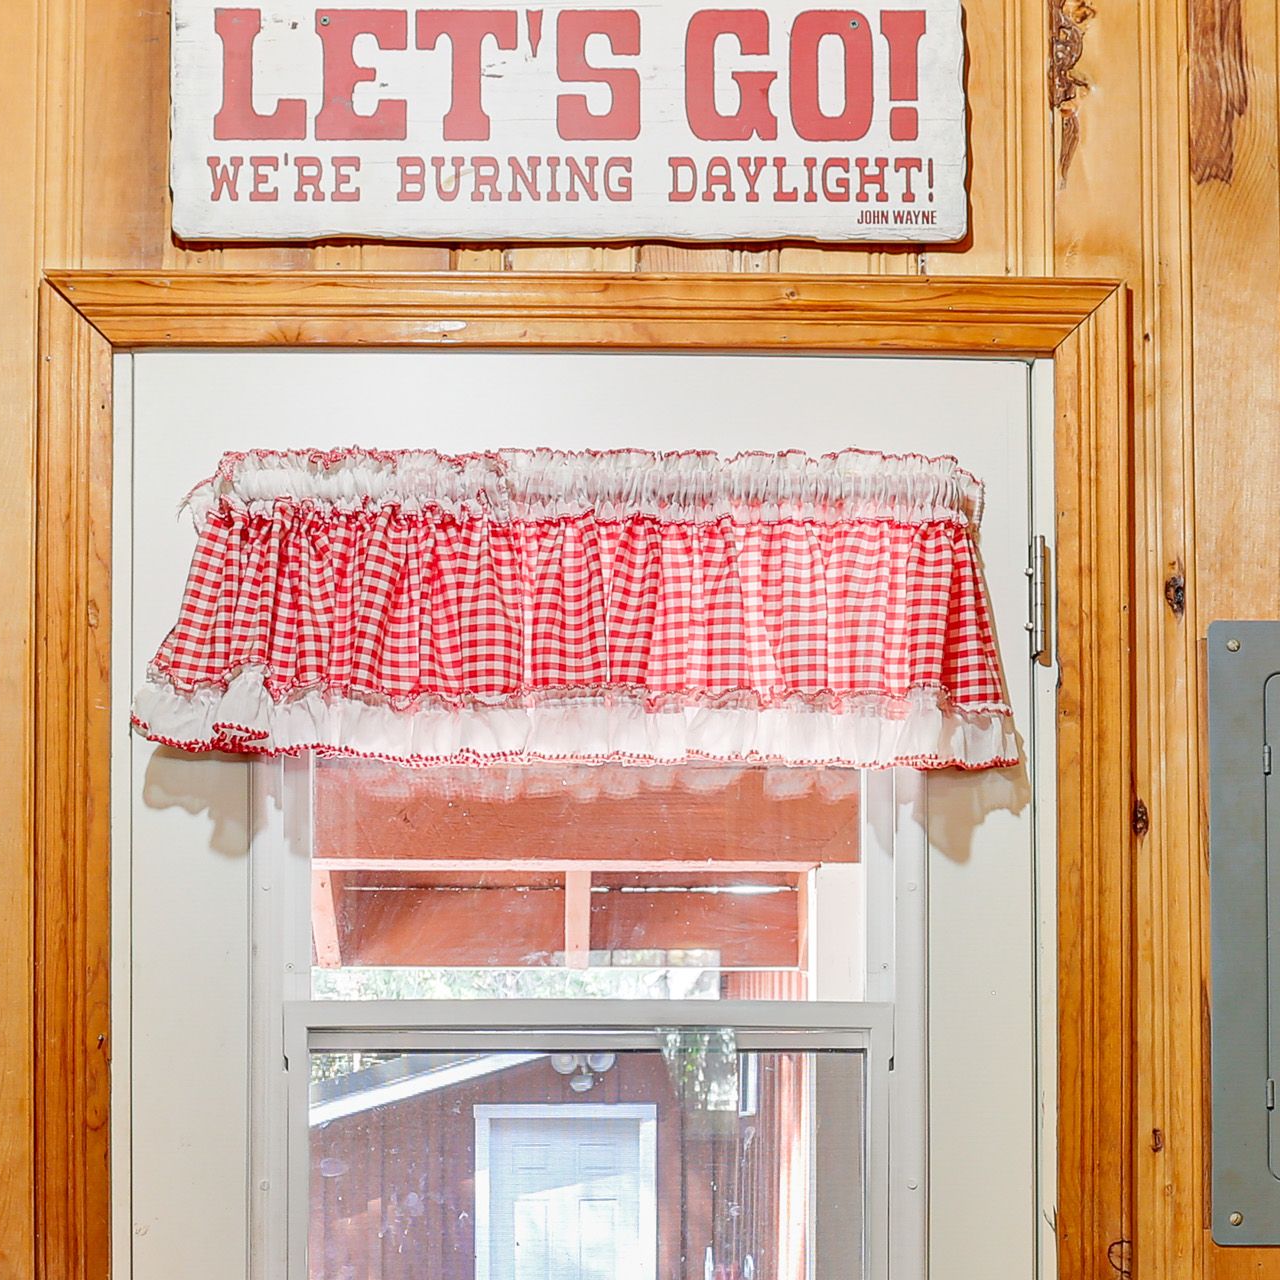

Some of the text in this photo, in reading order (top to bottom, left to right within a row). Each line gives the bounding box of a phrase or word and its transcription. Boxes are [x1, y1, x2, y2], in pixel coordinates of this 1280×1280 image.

[214, 8, 927, 142] LET'S GO!
[207, 154, 934, 203] WE'RE BURNING DAYLIGHT!
[857, 210, 937, 225] JOHN WAYNE
